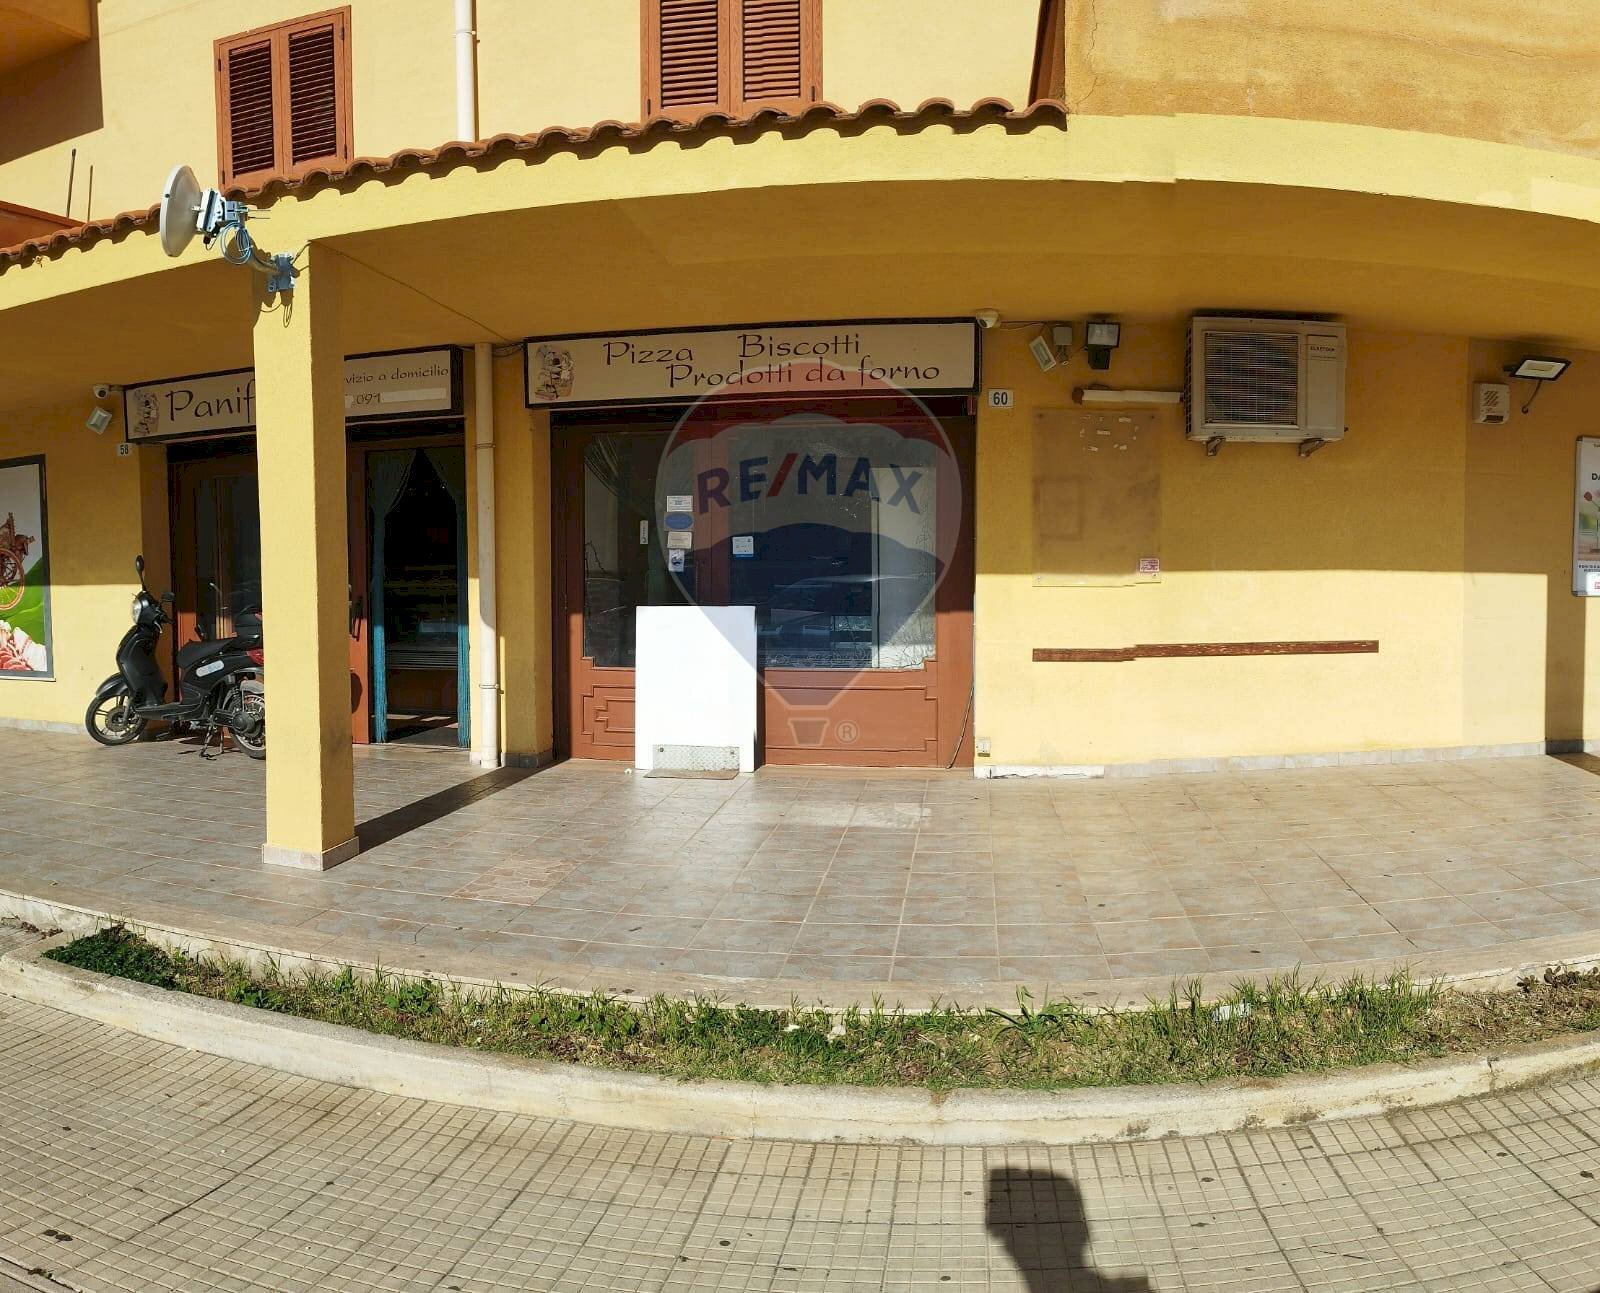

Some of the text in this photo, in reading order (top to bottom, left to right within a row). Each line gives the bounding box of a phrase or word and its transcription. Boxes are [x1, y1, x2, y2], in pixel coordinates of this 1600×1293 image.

[602, 333, 860, 365] Pizza Biscotti
[344, 364, 449, 384] vizio a domicilio
[665, 354, 940, 388] Prodotti da forno
[165, 378, 256, 423] Panif
[993, 391, 1008, 406] 60
[120, 444, 129, 455] 58
